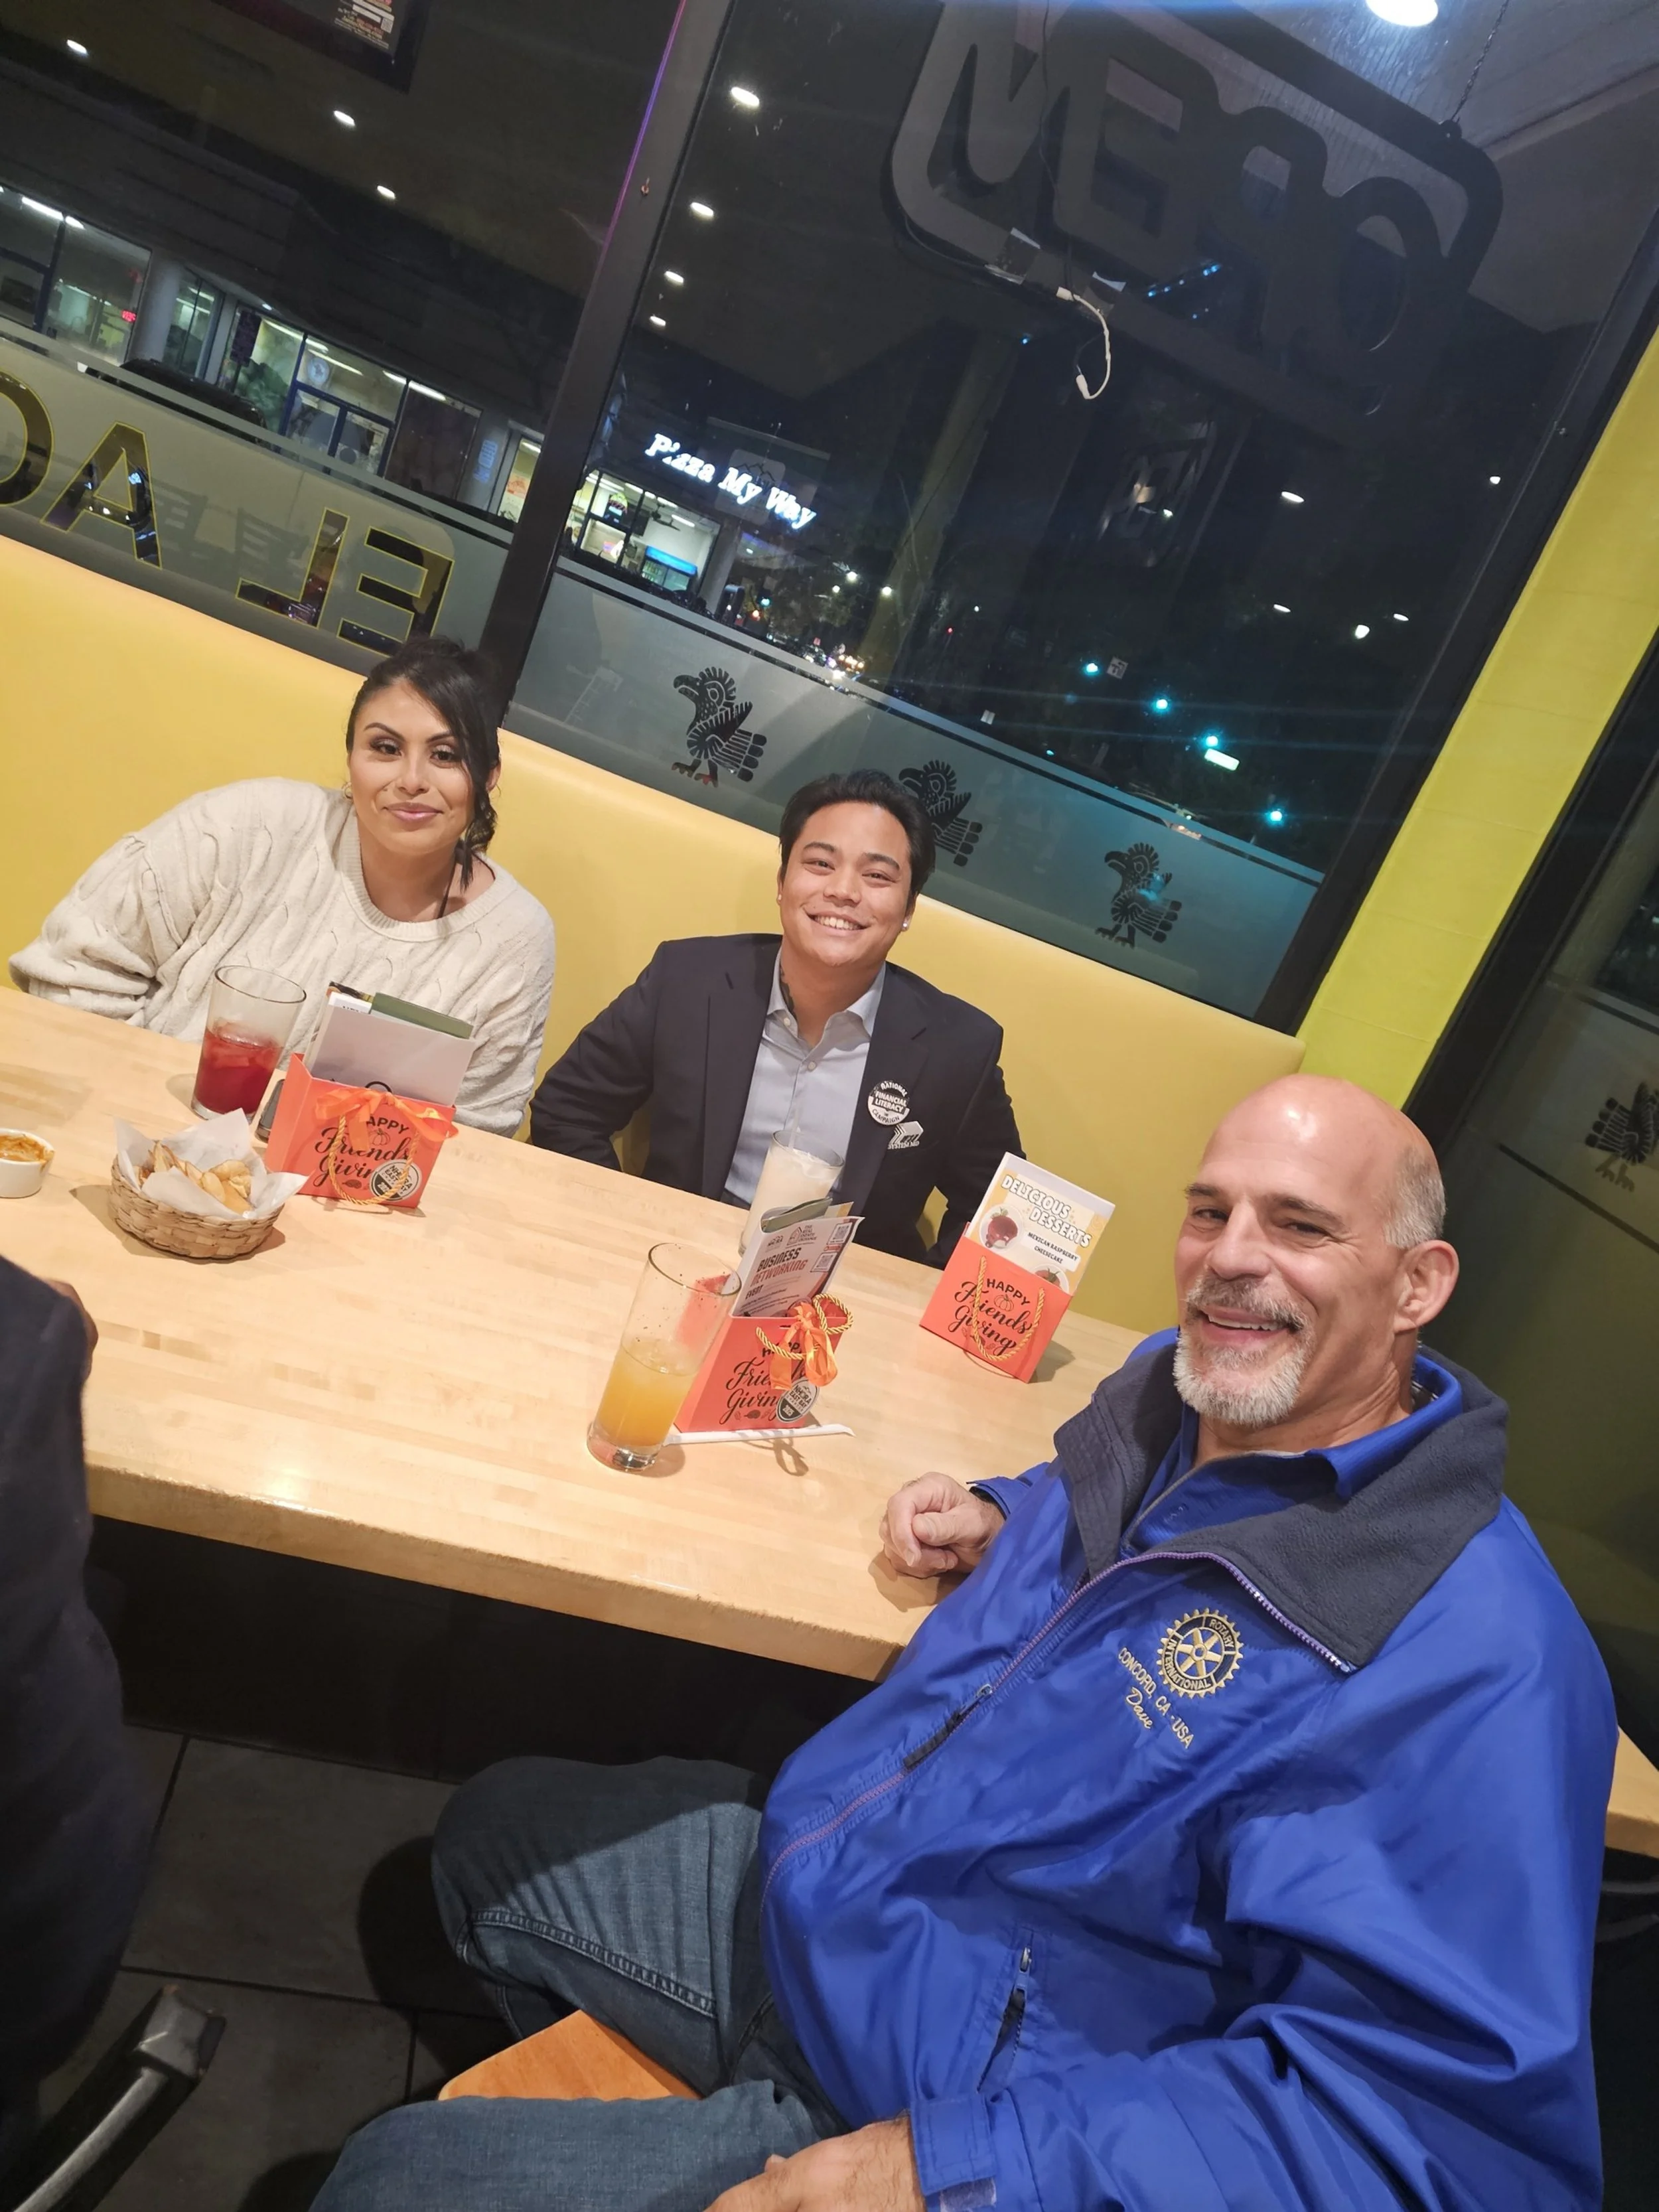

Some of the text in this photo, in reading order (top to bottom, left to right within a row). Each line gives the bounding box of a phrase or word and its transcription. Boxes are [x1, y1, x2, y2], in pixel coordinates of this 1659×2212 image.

[644, 433, 817, 529] Pizza My Way
[876, 1091, 907, 1107] FINANCIAL
[881, 1081, 907, 1096] NATIONAL
[873, 1109, 900, 1123] CAMPAIGN
[875, 1098, 904, 1112] LITERACY
[366, 1115, 409, 1134] APPY
[315, 1127, 411, 1161] Frinds
[1001, 1175, 1072, 1219] DELICIOUS
[1029, 1207, 1092, 1248] DESSERTS
[757, 1248, 802, 1272] BUSINESS
[1027, 1232, 1078, 1261] MEXICAN RASPBERRY
[1034, 1246, 1064, 1264] CHEESECAKE
[751, 1260, 808, 1287] NETWORKING
[745, 1284, 764, 1299] EVENT
[987, 1278, 1031, 1305] HAPPY
[790, 1390, 800, 1401] EAST
[1209, 1618, 1235, 1648] ROTARY
[1165, 1639, 1212, 1690] INTERNATIONAL
[1118, 1647, 1157, 1700] CONCORD,
[1155, 1696, 1171, 1716] CA
[1125, 1687, 1153, 1730] Dave
